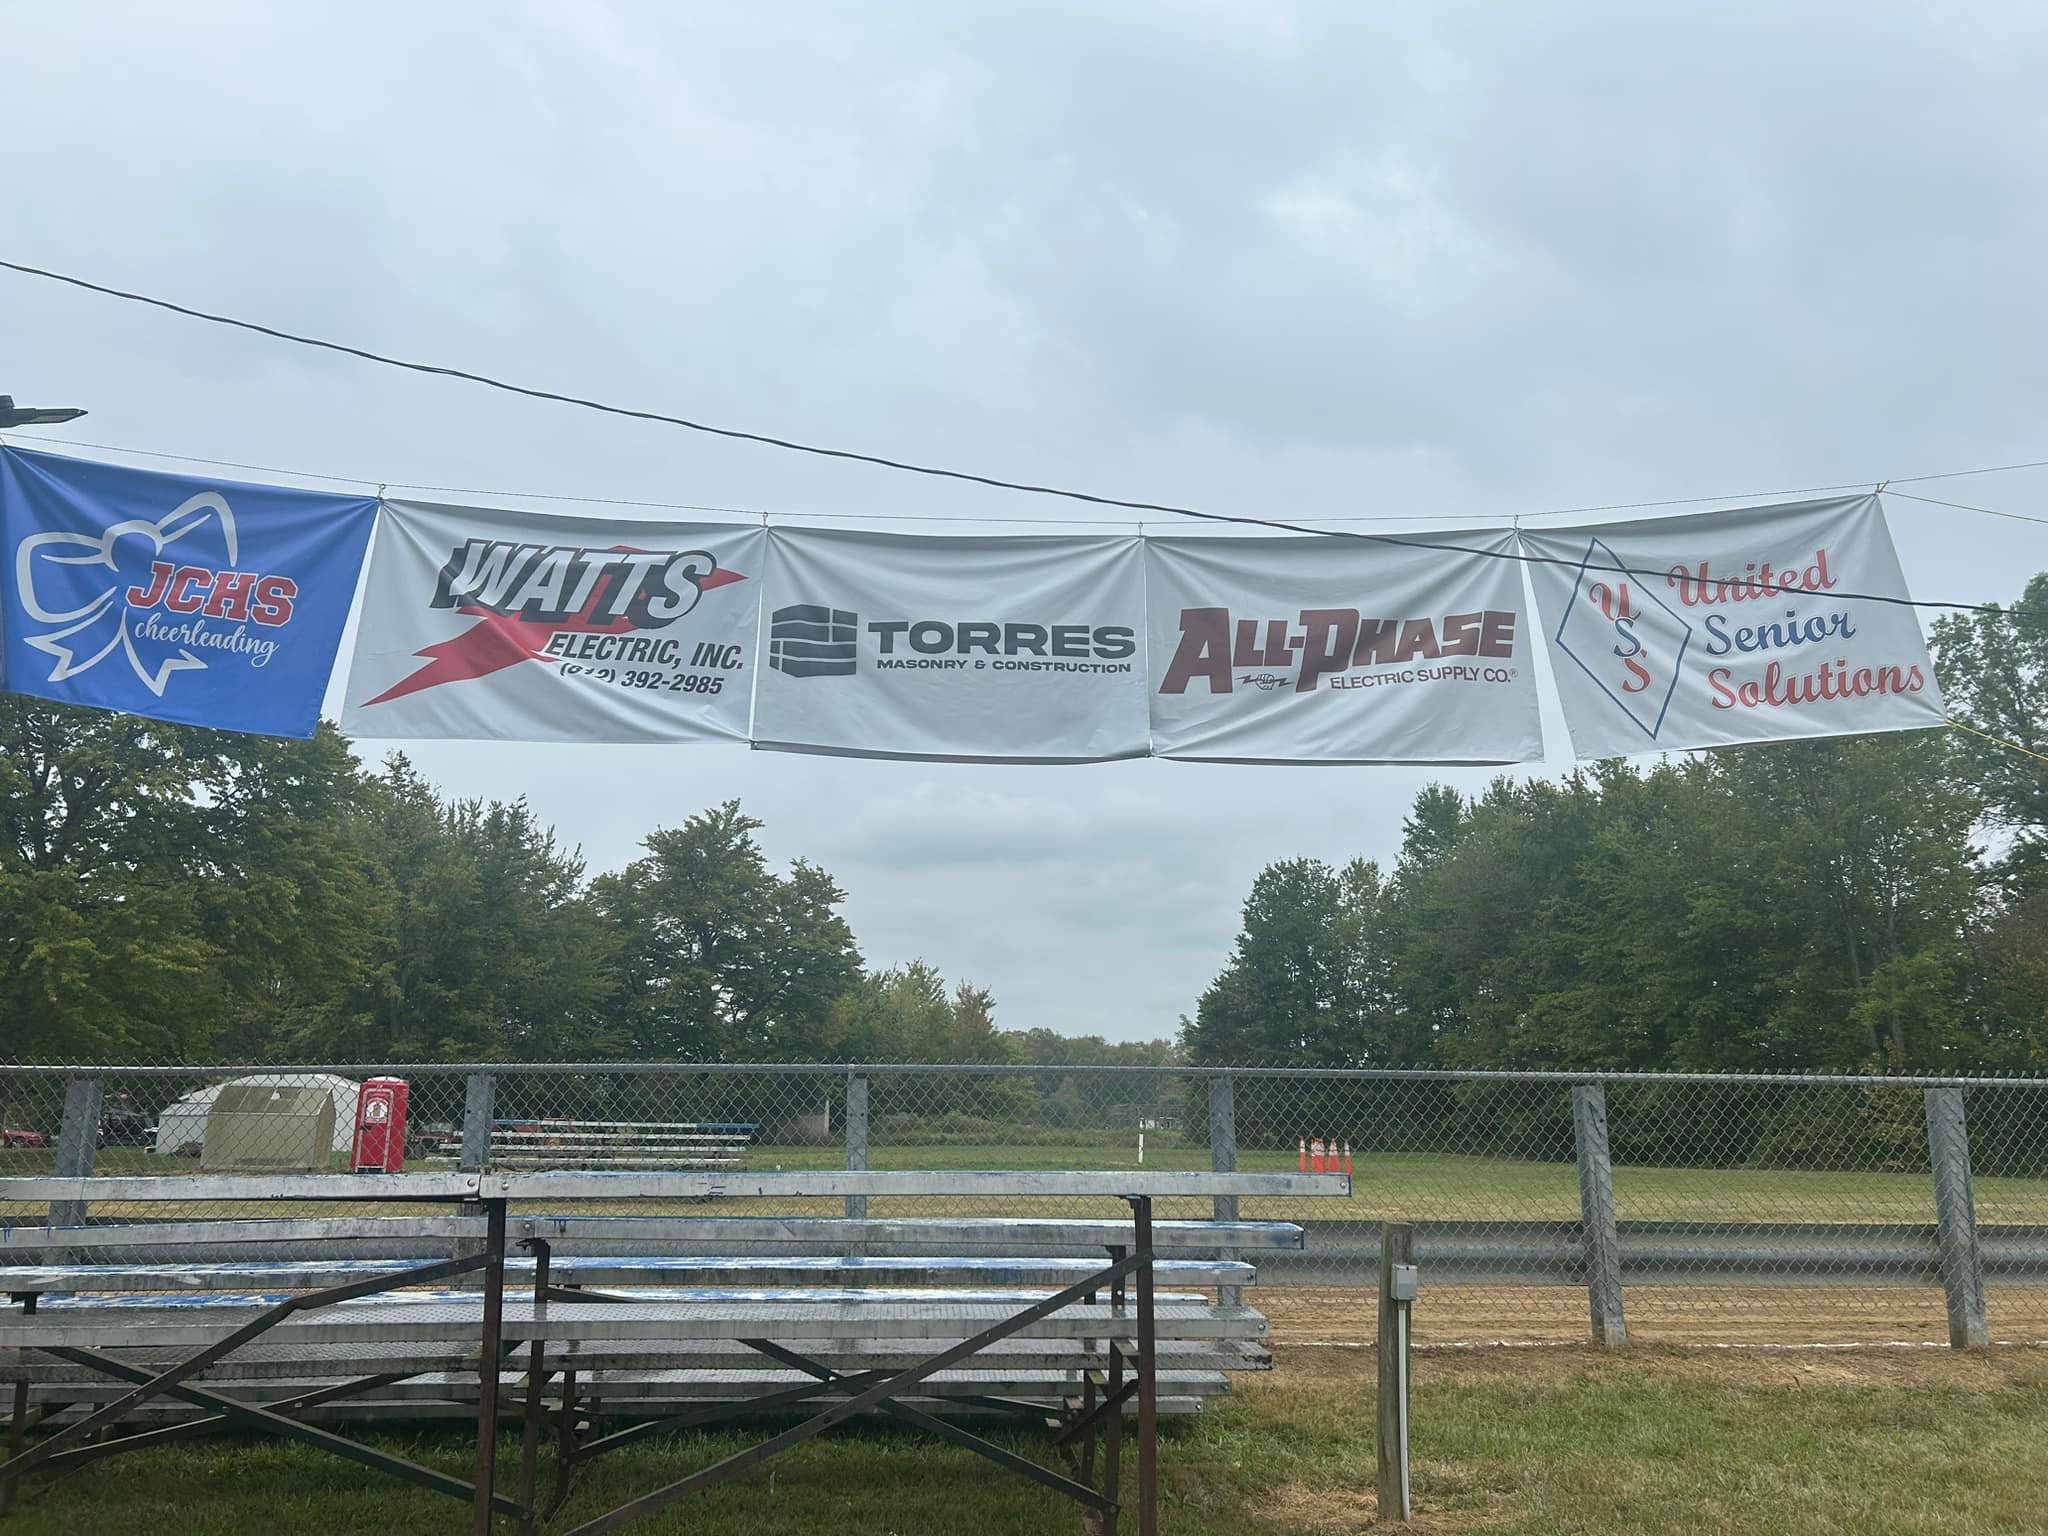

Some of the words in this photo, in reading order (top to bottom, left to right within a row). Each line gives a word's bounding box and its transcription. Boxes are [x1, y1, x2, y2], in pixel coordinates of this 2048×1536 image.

[125, 560, 298, 627] JCHS
[432, 538, 718, 629] WATTS
[1667, 549, 1837, 606] United
[134, 612, 280, 668] cheerleading
[545, 633, 682, 670] ELECTRIC,
[690, 641, 744, 670] INC.
[867, 621, 1136, 660] TORRES
[1158, 607, 1517, 694] ALL-PHASE
[1704, 608, 1857, 656] Senior
[621, 670, 725, 695] 392-2985
[876, 659, 969, 670] MASONRY
[973, 659, 986, 670] &
[992, 660, 1132, 674] CONSTRUCTION
[1329, 670, 1414, 690] ELECTRIC
[1418, 666, 1480, 683] SUPPLY
[1706, 658, 1926, 710] Solutions
